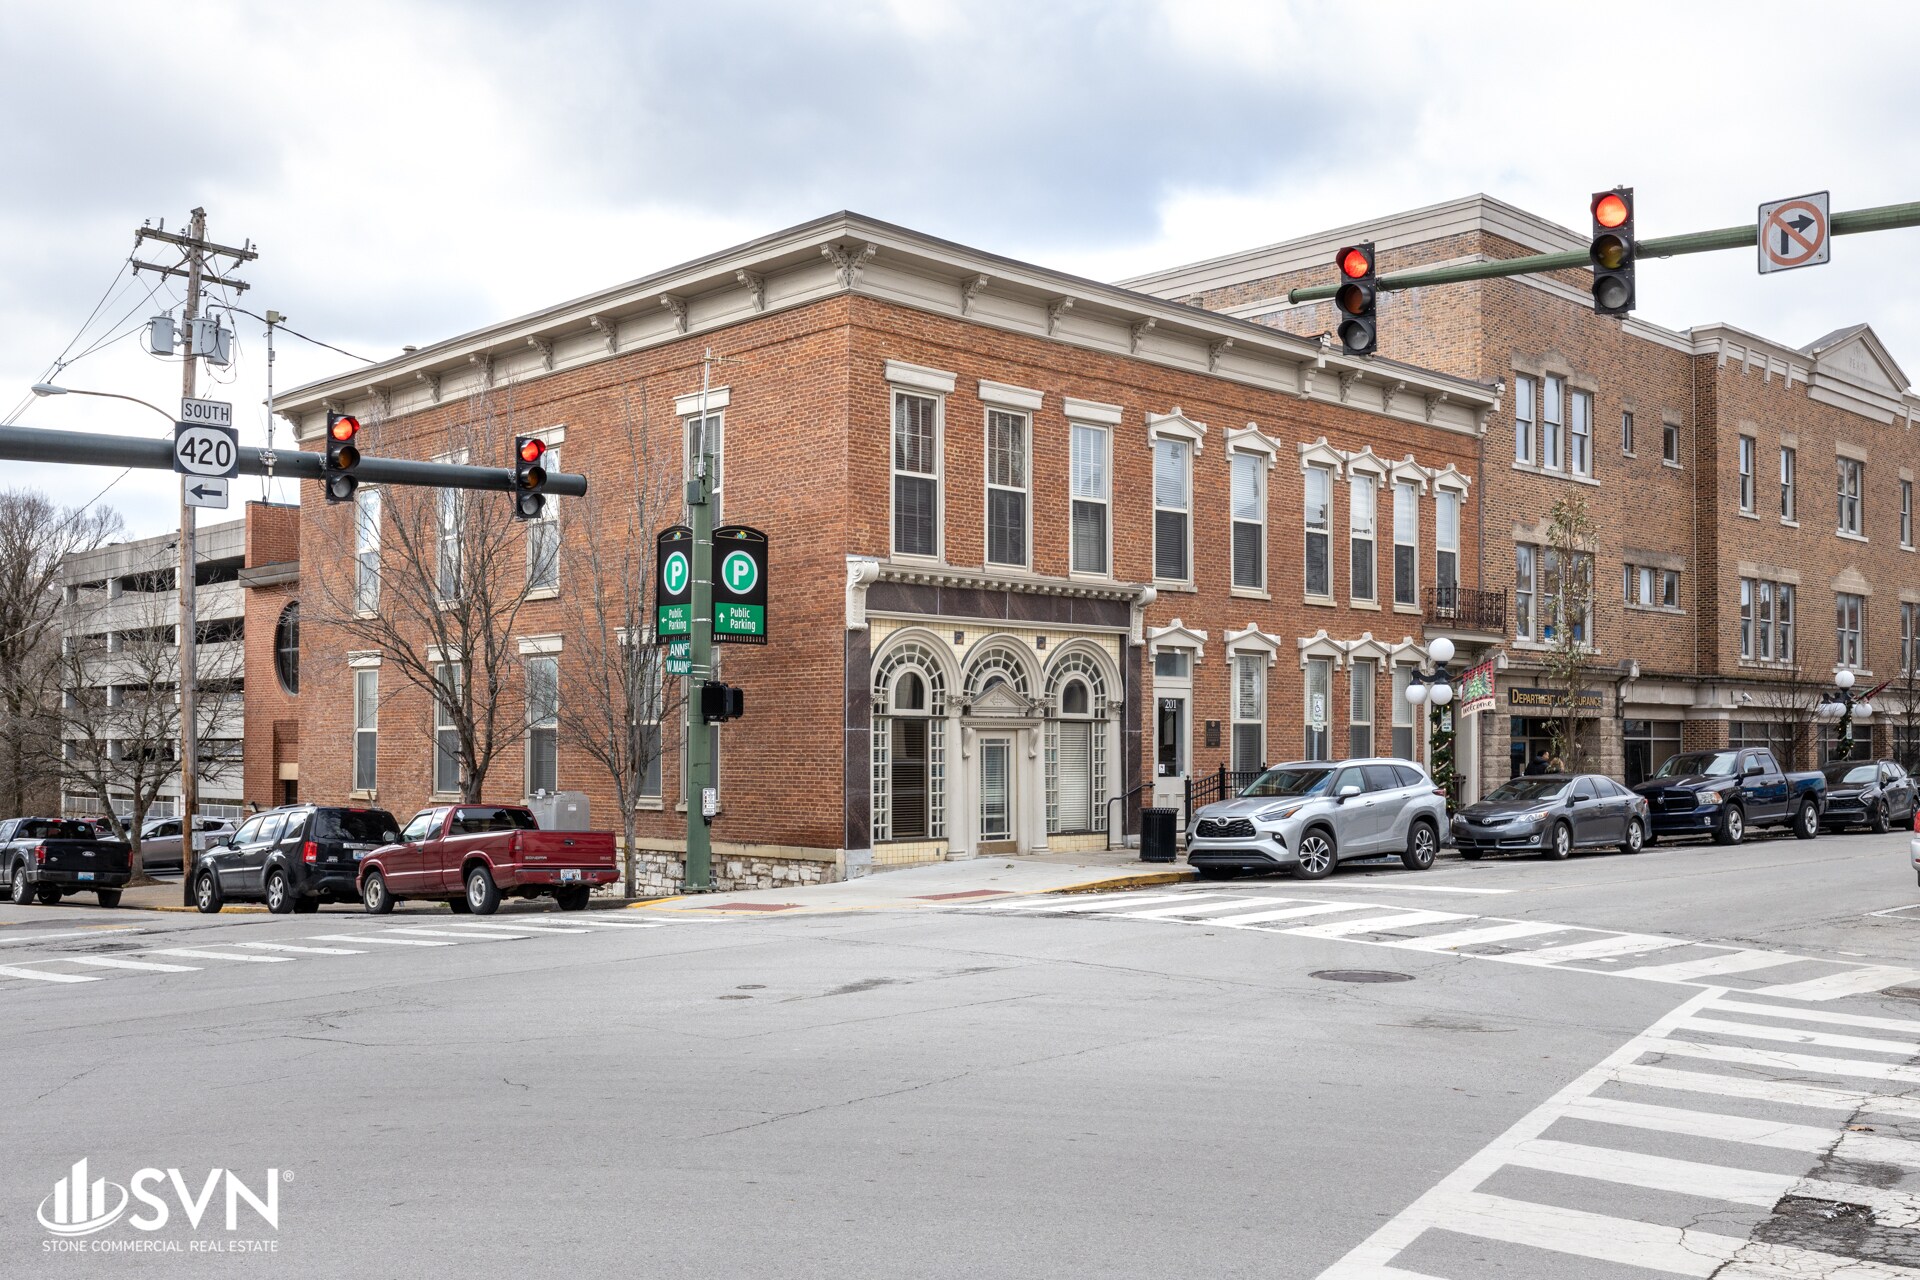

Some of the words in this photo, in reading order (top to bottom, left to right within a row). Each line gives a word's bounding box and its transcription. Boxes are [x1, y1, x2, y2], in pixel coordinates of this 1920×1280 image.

[185, 403, 229, 421] SOUTH
[180, 437, 231, 467] 420
[671, 561, 683, 587] P
[733, 560, 749, 586] P
[668, 608, 683, 618] Public
[730, 607, 750, 618] Public
[668, 620, 687, 632] Parking
[730, 619, 756, 632] Parking
[669, 643, 685, 656] ANN
[1164, 699, 1176, 709] 201
[1512, 688, 1555, 705] DEPARTMENT
[1568, 693, 1602, 707] SURANCE
[1463, 701, 1493, 714] welcome
